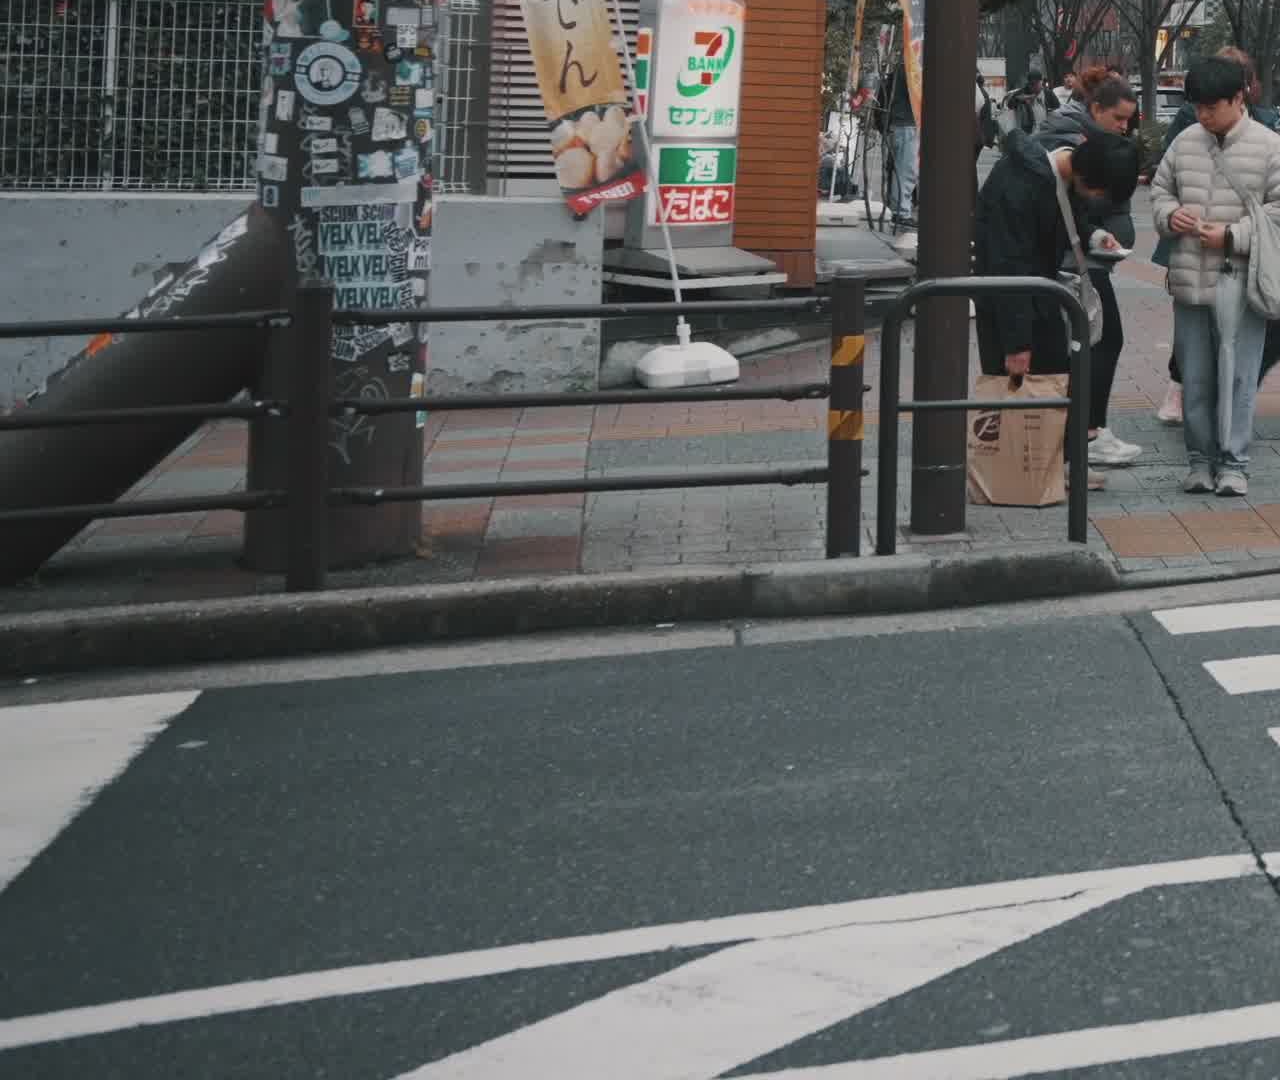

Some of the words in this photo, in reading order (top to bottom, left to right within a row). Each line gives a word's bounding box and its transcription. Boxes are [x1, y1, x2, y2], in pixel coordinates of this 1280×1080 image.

[687, 57, 724, 71] BANK
[668, 106, 735, 127] セブン銀行
[686, 149, 720, 183] 酒
[664, 189, 730, 221] たばこ
